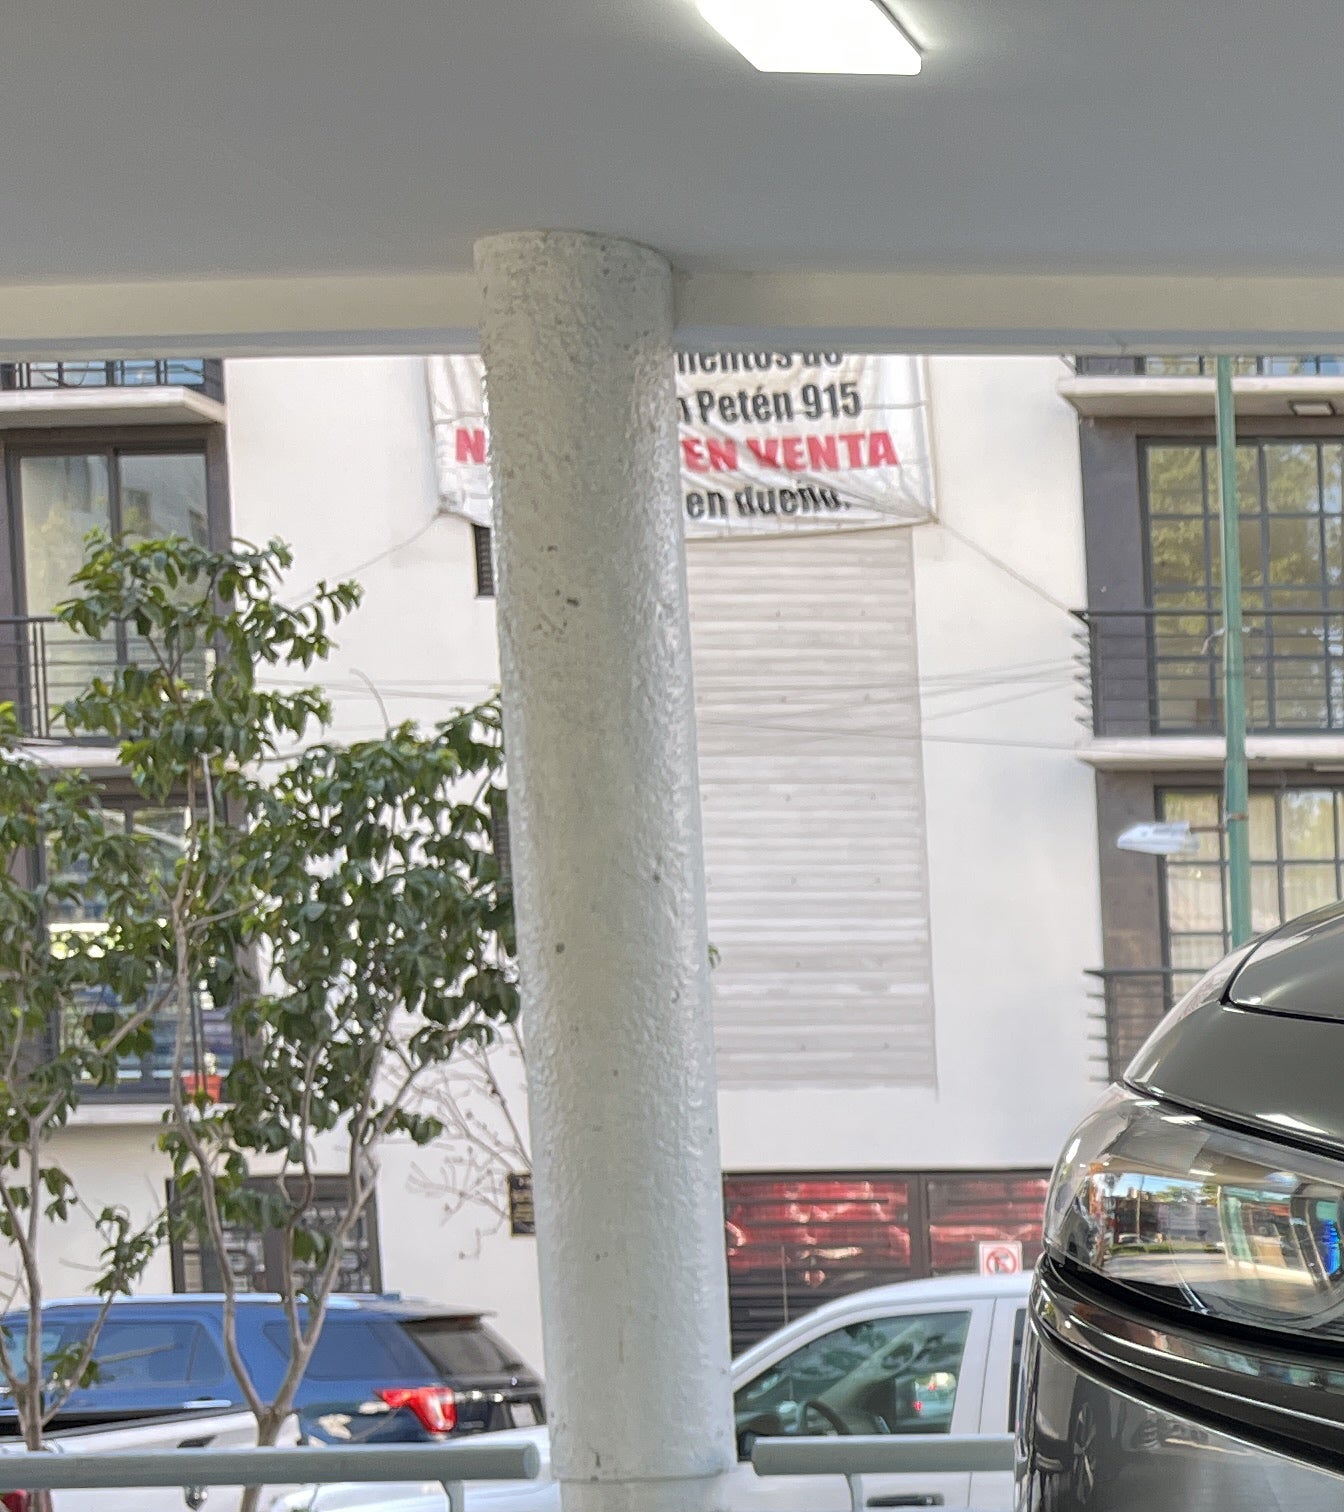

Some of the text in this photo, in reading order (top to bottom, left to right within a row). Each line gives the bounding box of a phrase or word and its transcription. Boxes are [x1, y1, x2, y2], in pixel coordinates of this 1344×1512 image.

[696, 384, 794, 424] Petén
[801, 381, 862, 420] 915
[681, 436, 739, 473] EN
[745, 430, 899, 472] VENTA
